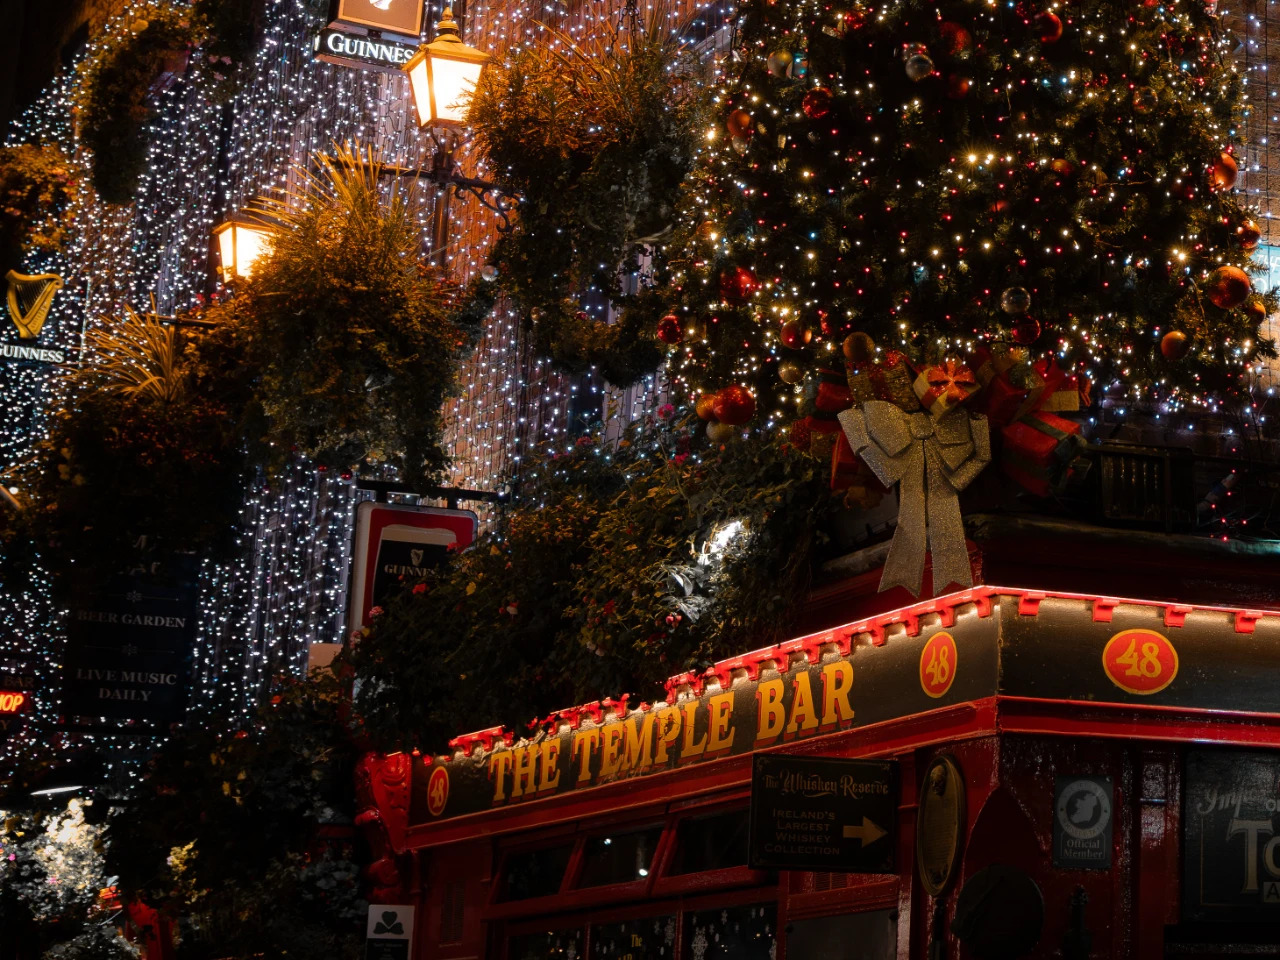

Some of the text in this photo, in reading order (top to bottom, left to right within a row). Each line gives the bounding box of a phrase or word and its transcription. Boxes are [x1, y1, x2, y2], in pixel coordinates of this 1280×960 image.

[327, 32, 415, 65] GUINNES
[384, 563, 436, 577] GUINNES
[77, 610, 187, 628] BEER GARDEN
[926, 645, 950, 687] 48
[1116, 639, 1162, 678] 48
[76, 668, 177, 686] LIVE MUSIC
[98, 687, 153, 702] DAILY
[430, 660, 855, 809] 48 THE TEMPLE BAR
[779, 768, 838, 798] Whiskey
[839, 775, 889, 800] Reserve
[772, 807, 836, 820] IRELAND'S
[776, 820, 830, 832] LARGEST
[775, 831, 831, 843] WHISKEY
[1066, 839, 1100, 849] Official
[764, 843, 840, 856] COLLECTION
[1063, 849, 1103, 858] Member
